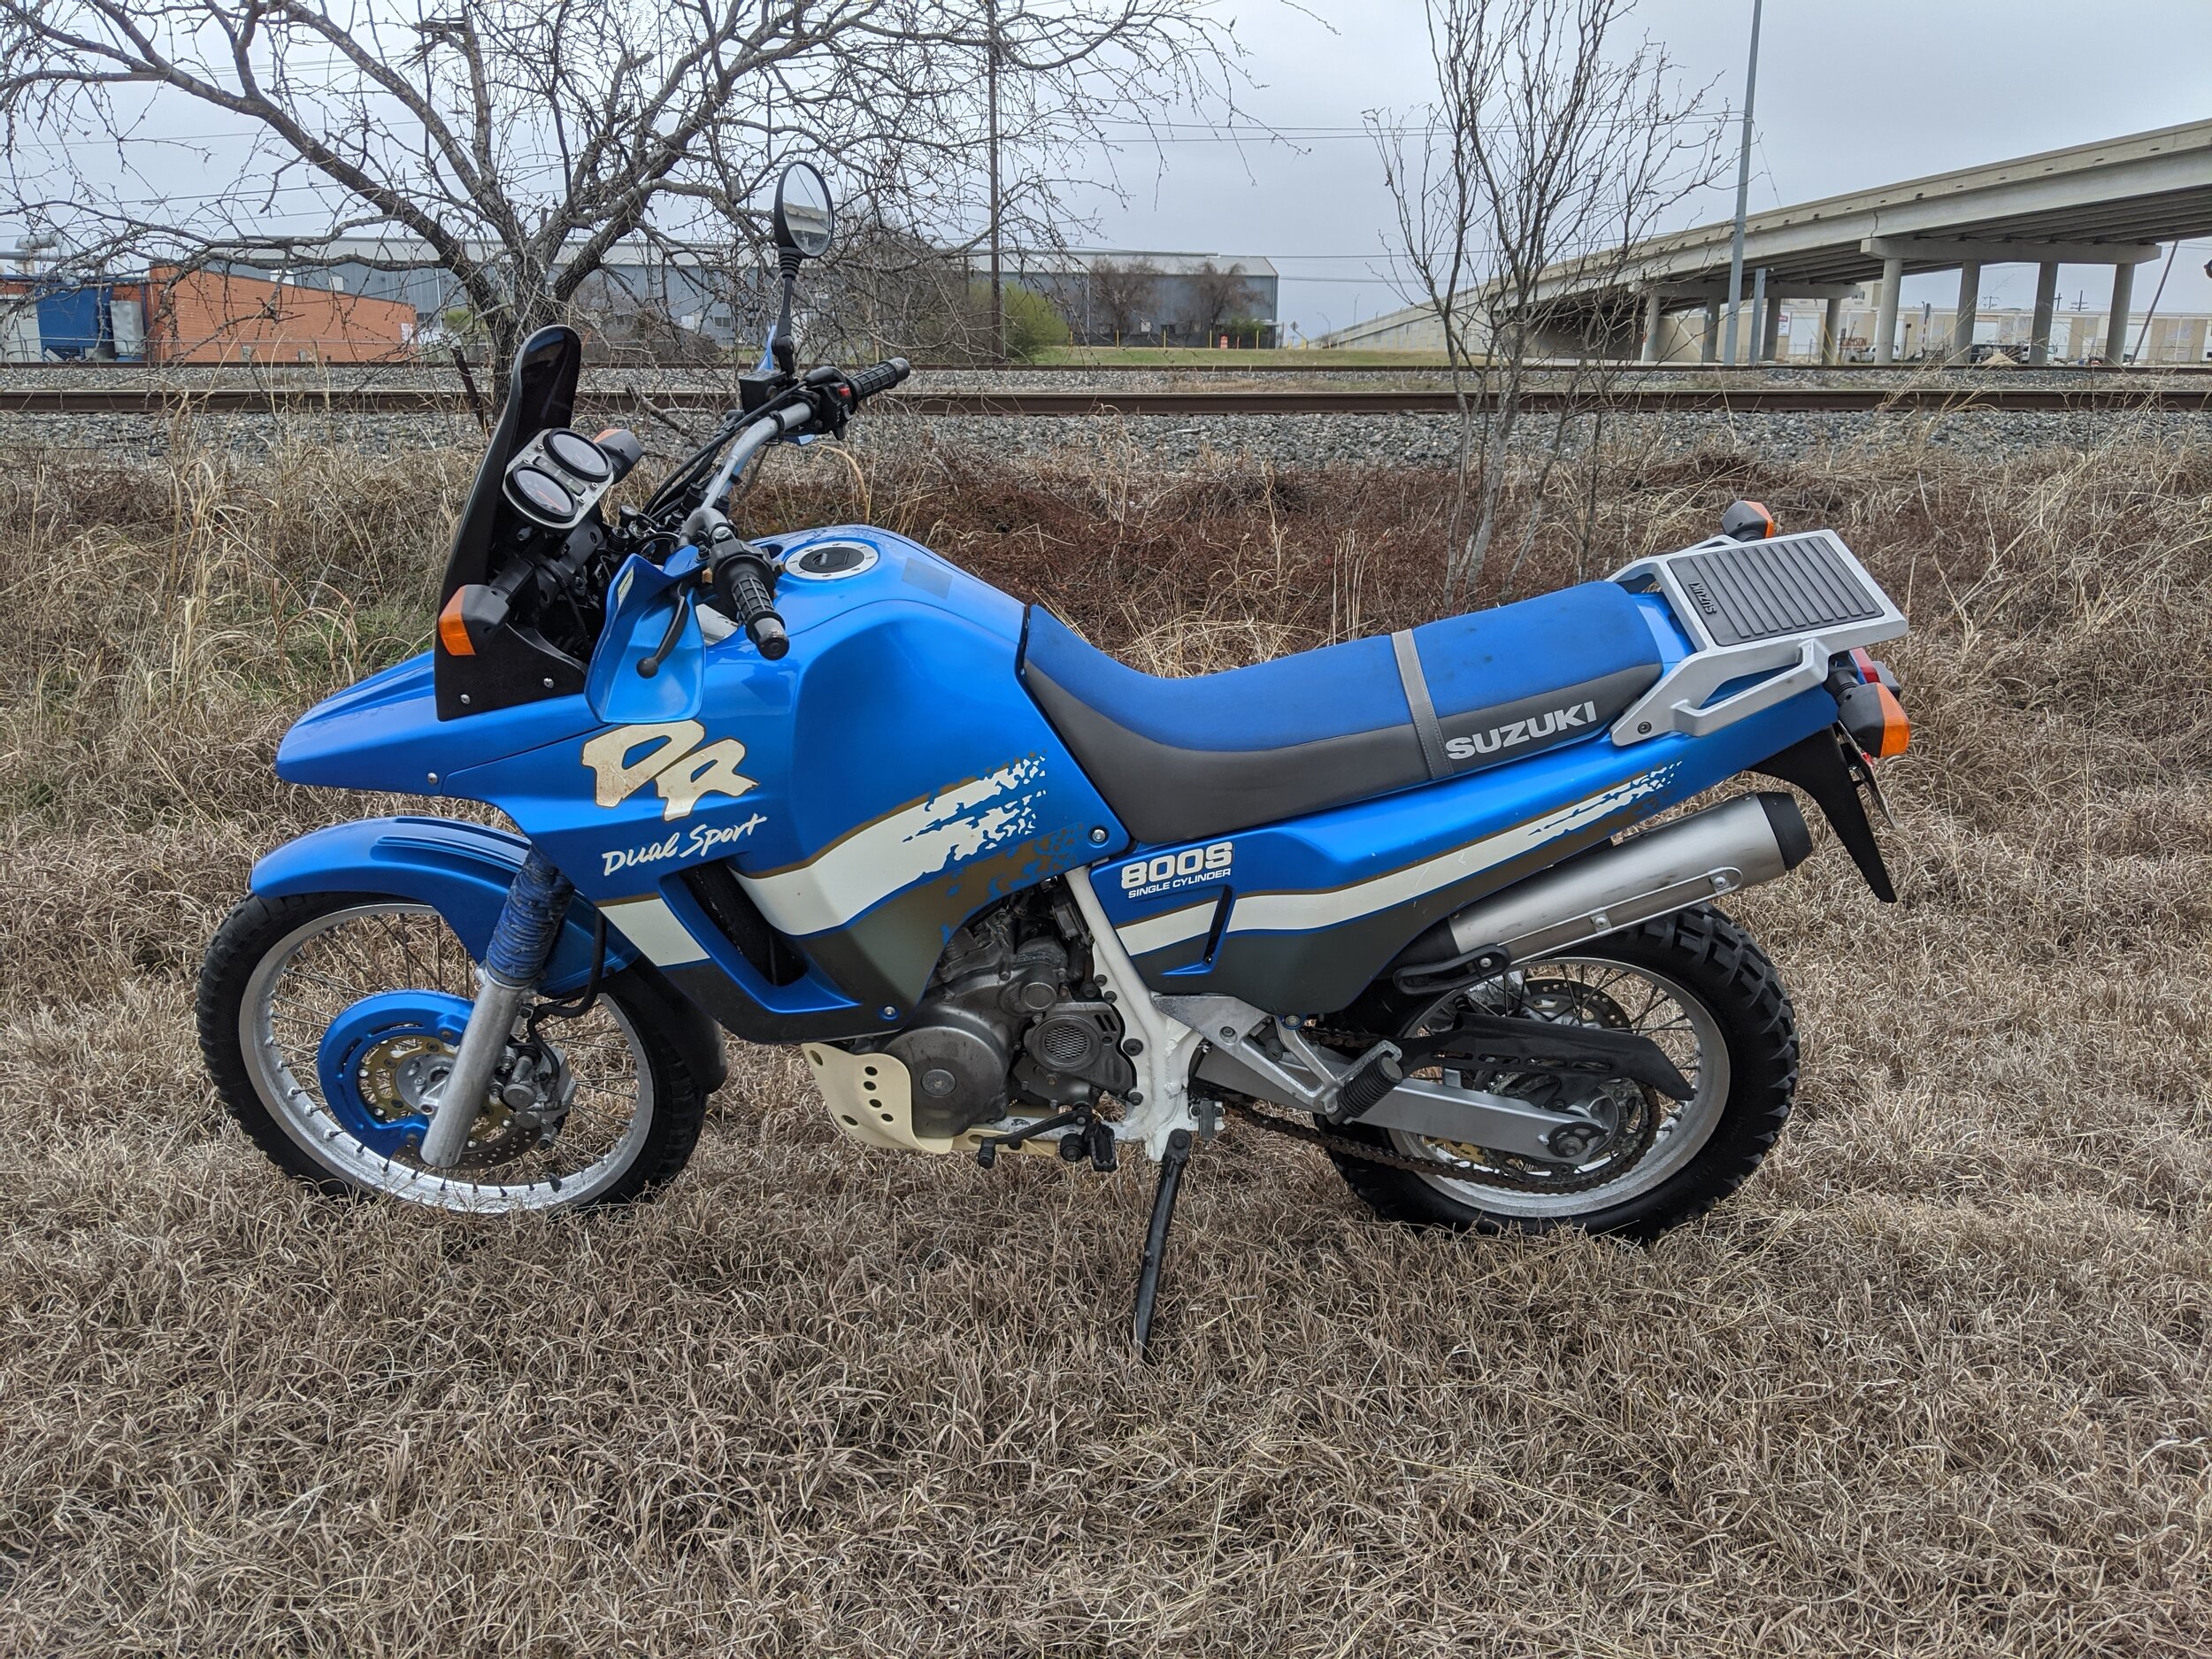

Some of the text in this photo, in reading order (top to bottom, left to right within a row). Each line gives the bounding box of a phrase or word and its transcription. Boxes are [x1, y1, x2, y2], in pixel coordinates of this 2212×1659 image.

[1689, 581, 1717, 615] SUZUKI
[1445, 701, 1597, 760] SUZUKI
[680, 813, 767, 857] Sport
[1121, 841, 1233, 889] 800S
[1128, 867, 1232, 899] SINGLE CYLINDER
